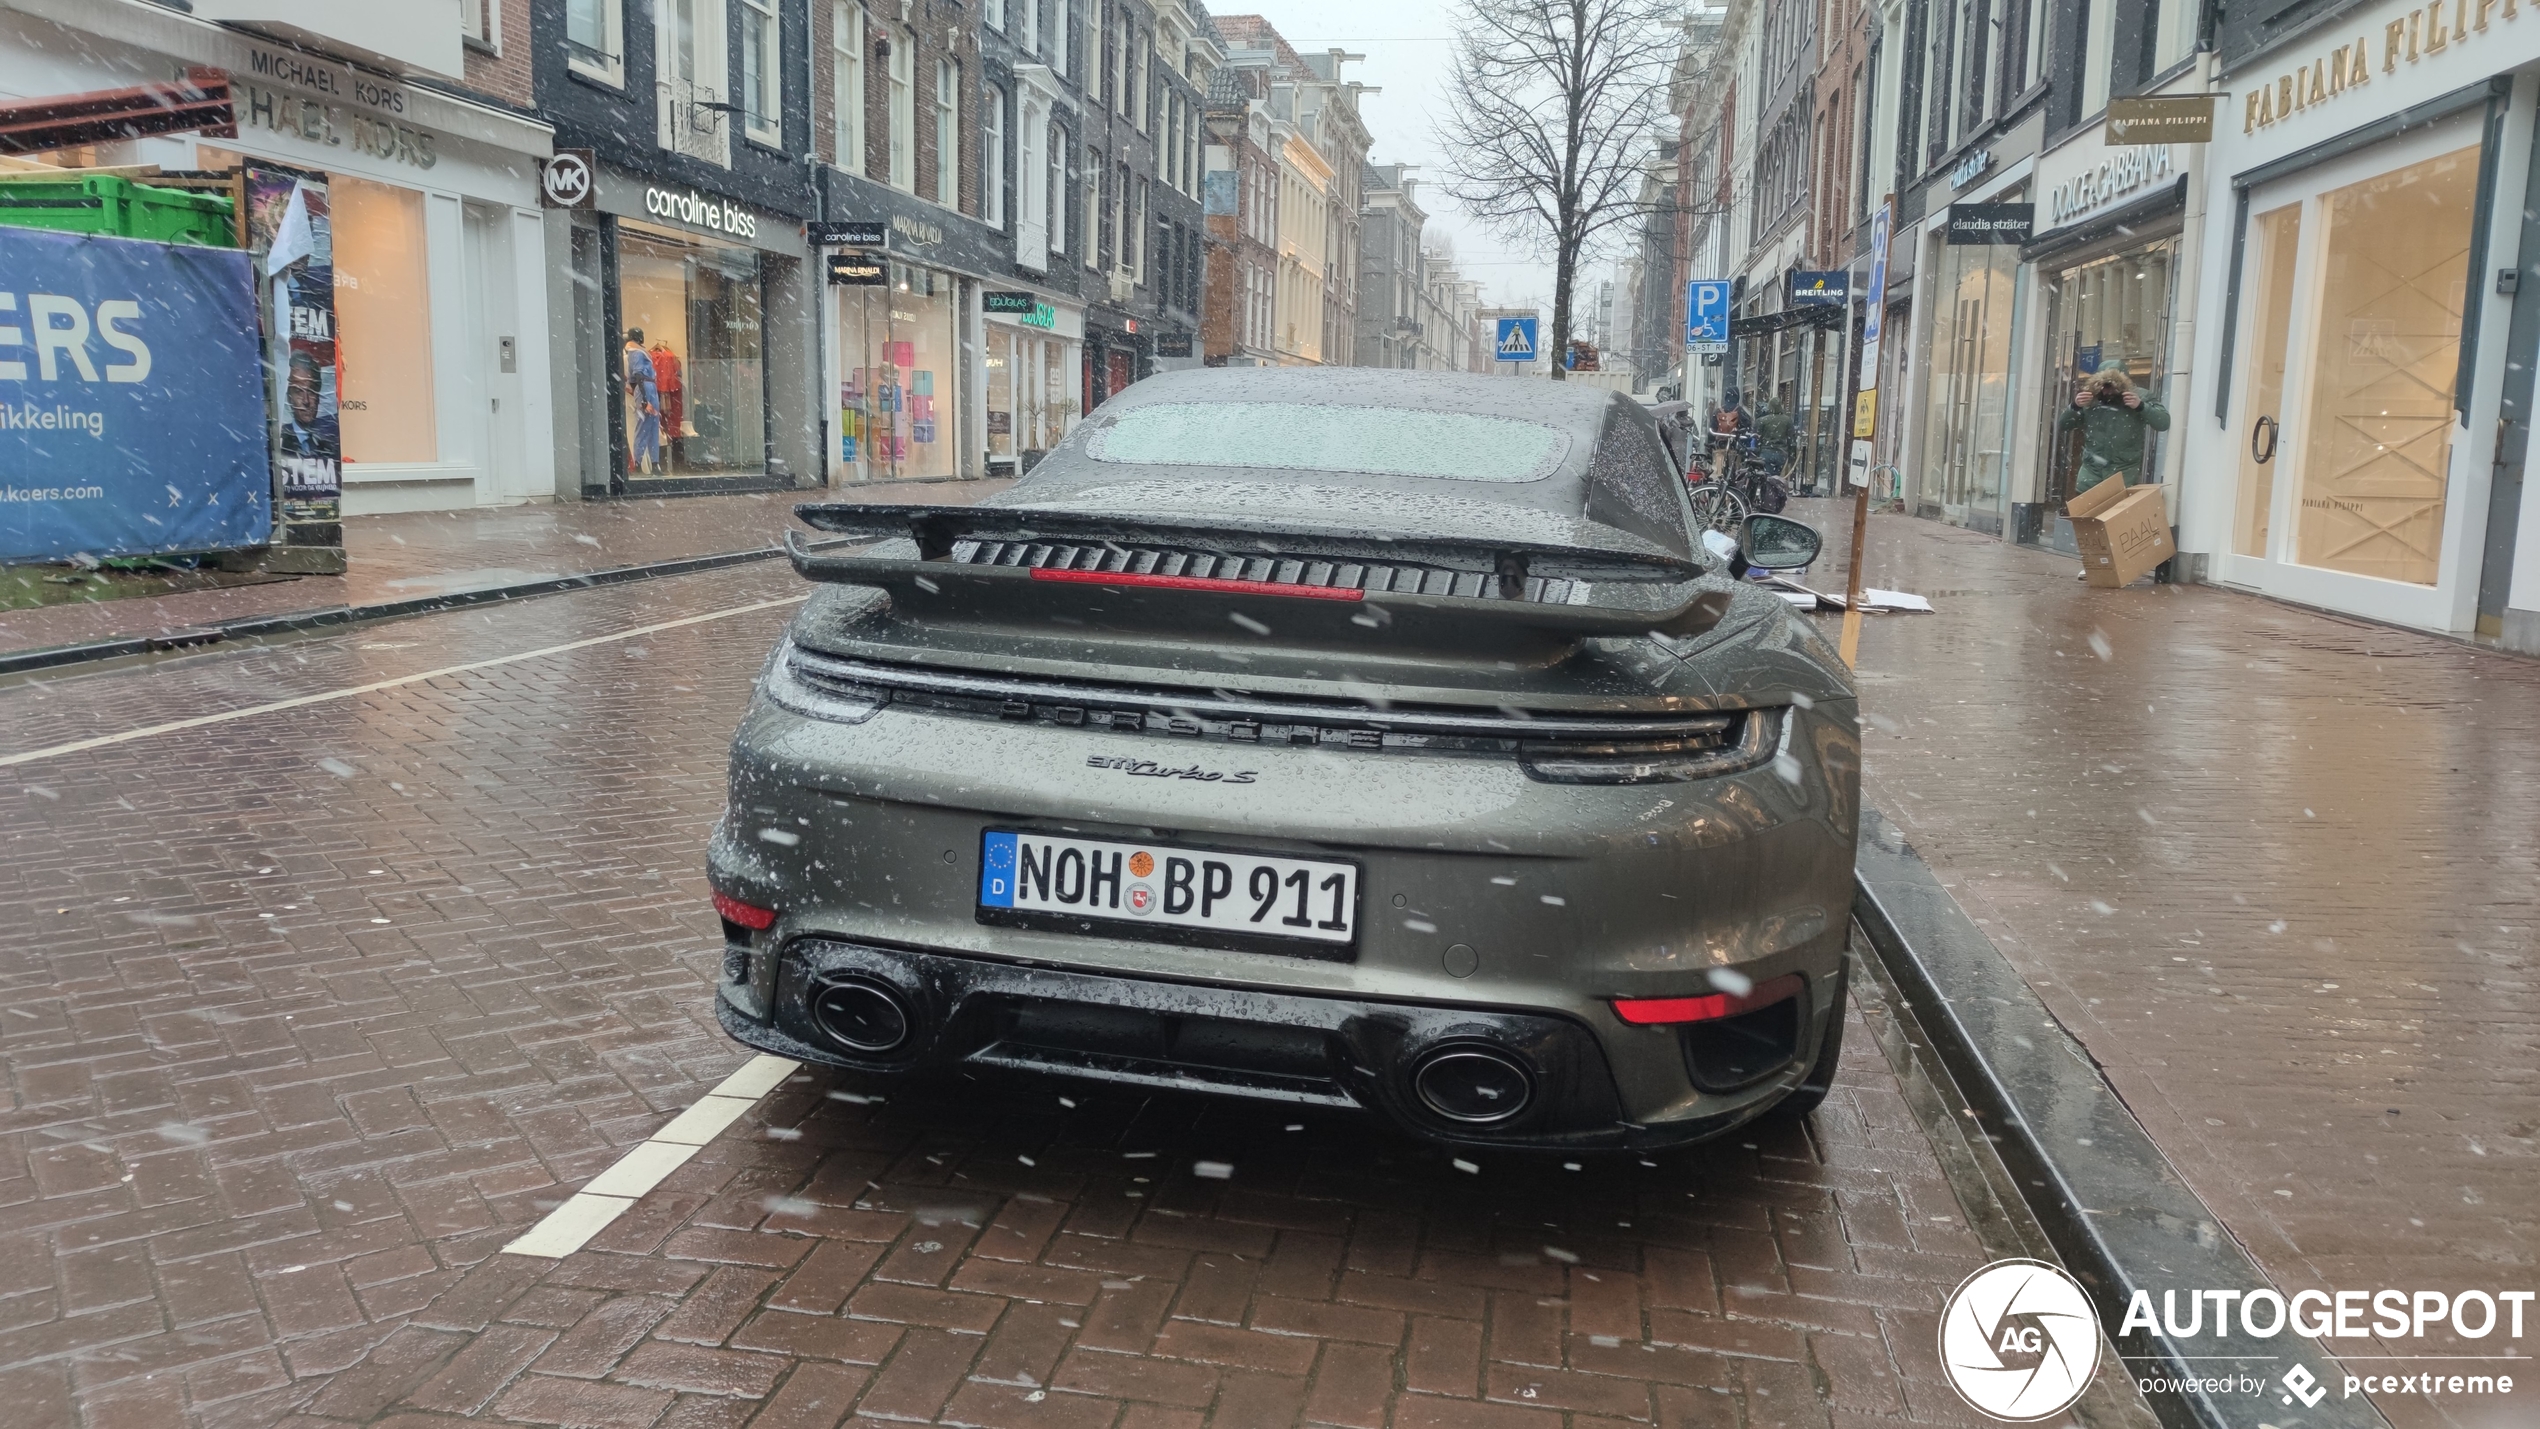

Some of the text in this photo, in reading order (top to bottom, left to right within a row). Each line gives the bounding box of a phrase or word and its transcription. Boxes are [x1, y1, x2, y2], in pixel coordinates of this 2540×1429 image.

[2243, 0, 2540, 134] FABIANA FILIP
[251, 49, 404, 114] MICHAEL KORS
[2115, 116, 2207, 127] FABIANA FILIPPI
[352, 113, 438, 170] KORS
[550, 168, 584, 190] MK
[646, 187, 756, 238] caroline biss
[892, 213, 942, 245] MARINA RINALDI
[1952, 218, 2030, 230] claudia sträter
[825, 232, 880, 242] caroline biss
[834, 266, 880, 275] MARINA RINALDI
[1795, 289, 1844, 297] BREITLING
[990, 297, 1027, 308] DOUGLAS
[341, 400, 368, 411] KORS
[2302, 498, 2330, 509] FABIANA
[2119, 518, 2160, 553] PAAL
[1001, 701, 1384, 749] PORSCHE
[1222, 770, 1259, 784] S
[992, 878, 1005, 895] D
[1018, 842, 1123, 909] NOH
[1163, 856, 1233, 918] BP
[1248, 865, 1348, 932] 911
